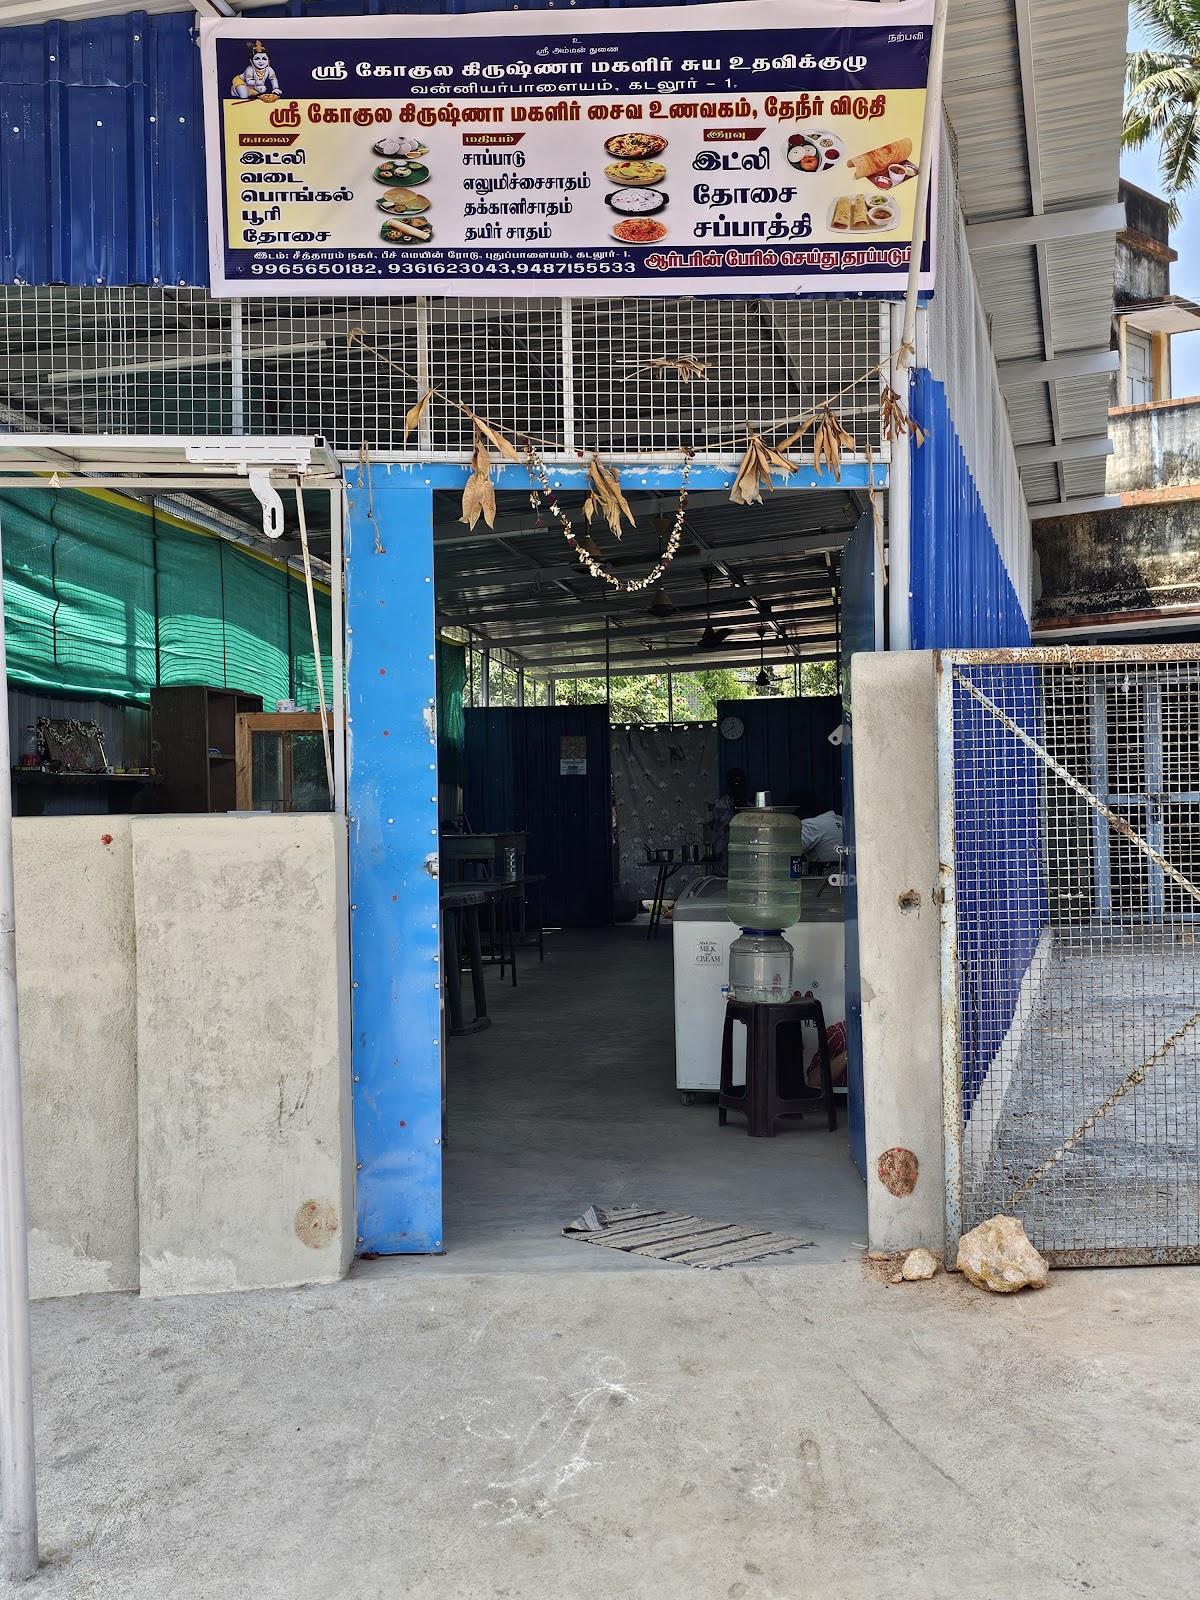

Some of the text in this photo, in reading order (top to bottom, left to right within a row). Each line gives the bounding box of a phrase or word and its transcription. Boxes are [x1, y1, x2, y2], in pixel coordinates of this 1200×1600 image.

[887, 31, 924, 44] நற்பவி
[536, 46, 619, 57] ஸ்ரீ அம்மன் துணை
[311, 53, 868, 81] ஸ்ரீ கோகுல கிருஷ்ணா மகளிர் சுய உதவிக்குழு
[628, 76, 699, 94] கடலூர்
[269, 93, 886, 128] ஸ்ரீ கோகுல கிருஷ்ணா மகளிர் சைவ உணவகம், தேநீர் விடுதி
[465, 134, 515, 144] மதியம்
[706, 130, 746, 140] இரவு
[239, 148, 306, 165] இட்லி
[462, 148, 526, 168] சாப்பாடு
[692, 146, 770, 171] இட்லி
[240, 172, 304, 183] வடை
[463, 171, 591, 196] எலுமிச்சைசாதம்
[241, 186, 354, 202] பொங்கல்
[693, 183, 798, 210] தோசை
[242, 205, 281, 226] பூரி
[463, 196, 573, 218] தக்காளிசாதம்
[242, 228, 331, 246] தோசை
[464, 221, 552, 243] தயிர் சாதம்
[693, 212, 813, 242] சப்பாத்தி
[644, 249, 723, 271] ஆர்டரின்
[725, 249, 779, 267] பேரில்
[780, 247, 840, 270] செய்து
[250, 263, 383, 276] 9965650182,
